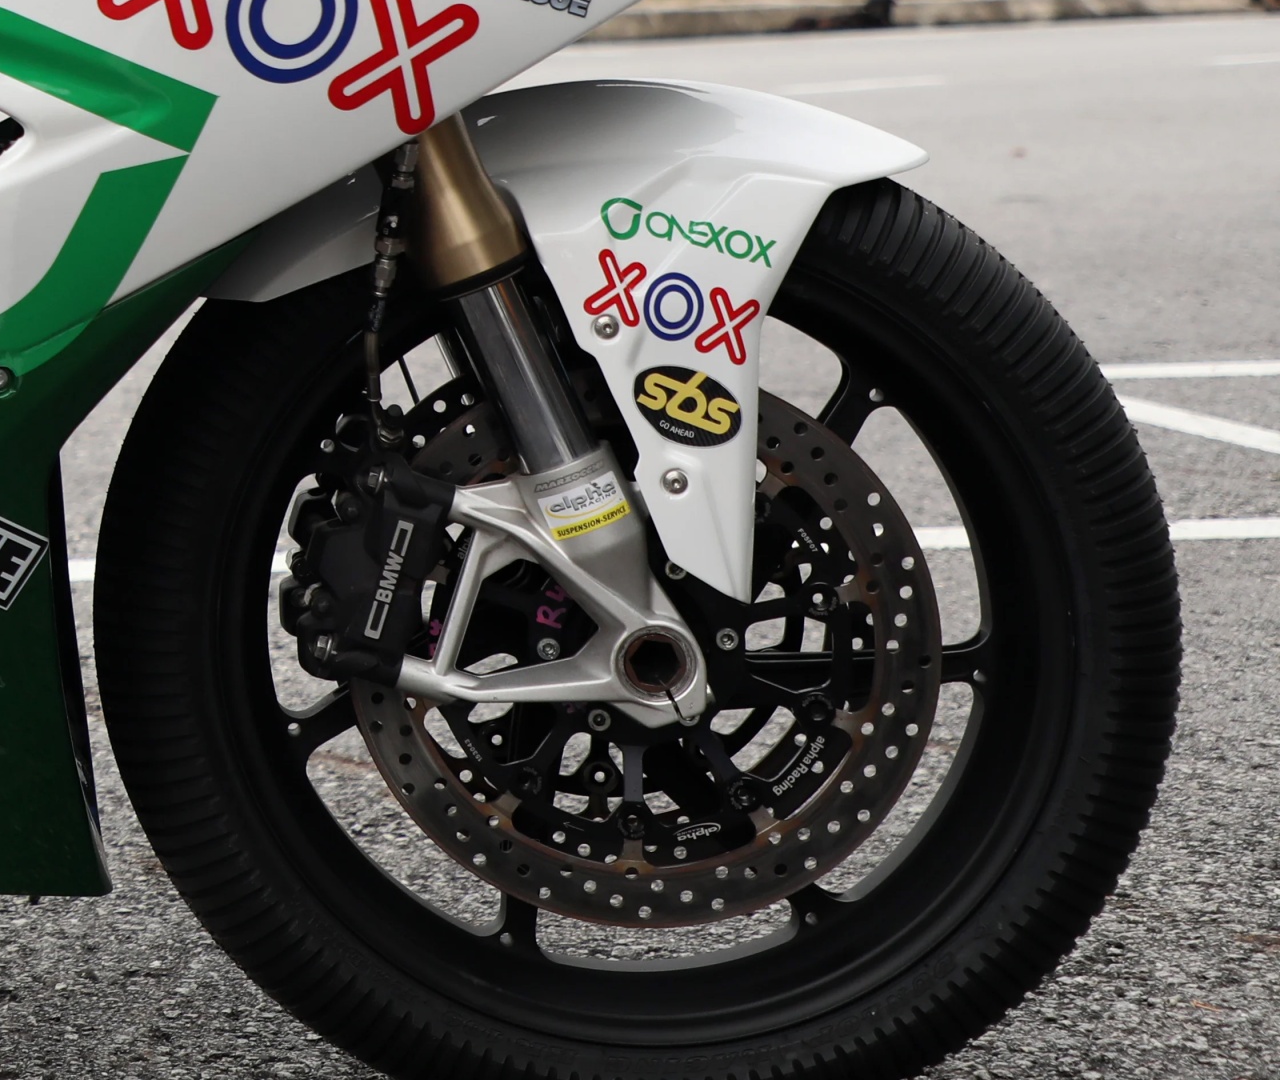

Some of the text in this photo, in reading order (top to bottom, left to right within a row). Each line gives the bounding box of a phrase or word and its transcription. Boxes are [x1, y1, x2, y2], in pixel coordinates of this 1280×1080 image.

[645, 211, 776, 268] ONEXOX
[584, 249, 760, 365] XOX
[637, 371, 740, 435] sbs
[659, 419, 695, 439] GO AHEAD
[535, 461, 604, 492] MARZOCCHI
[550, 480, 616, 513] alpha
[580, 489, 617, 509] RACING
[556, 504, 628, 537] SUSPENSION-SERVICE
[374, 550, 405, 604] BMW
[800, 735, 826, 765] alpha
[772, 763, 810, 797] Racing
[676, 825, 718, 842] alpha
